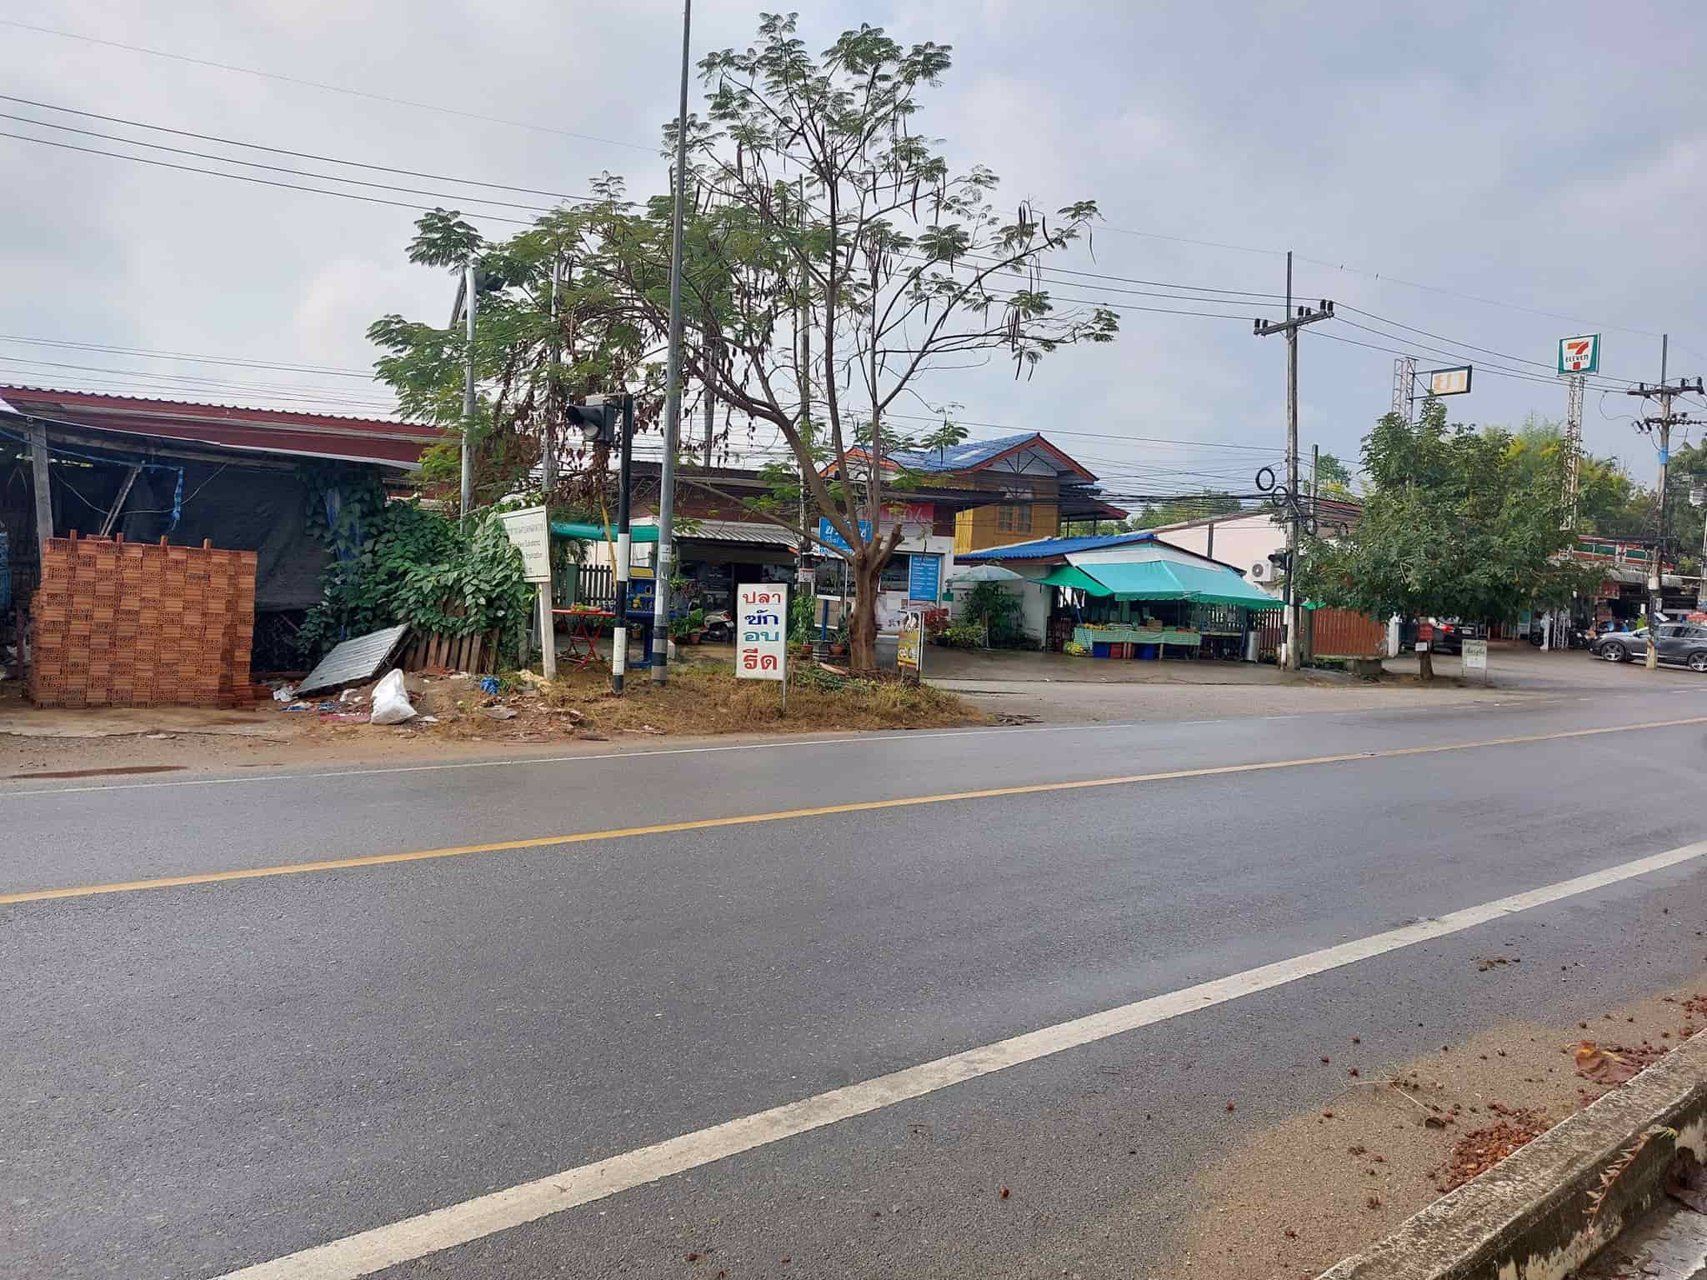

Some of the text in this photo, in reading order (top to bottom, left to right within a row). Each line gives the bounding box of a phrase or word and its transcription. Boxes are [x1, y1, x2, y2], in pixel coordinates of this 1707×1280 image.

[1567, 341, 1589, 355] 7
[742, 591, 781, 604] ปลา
[743, 631, 780, 642] อบ
[742, 648, 778, 670] รีด
